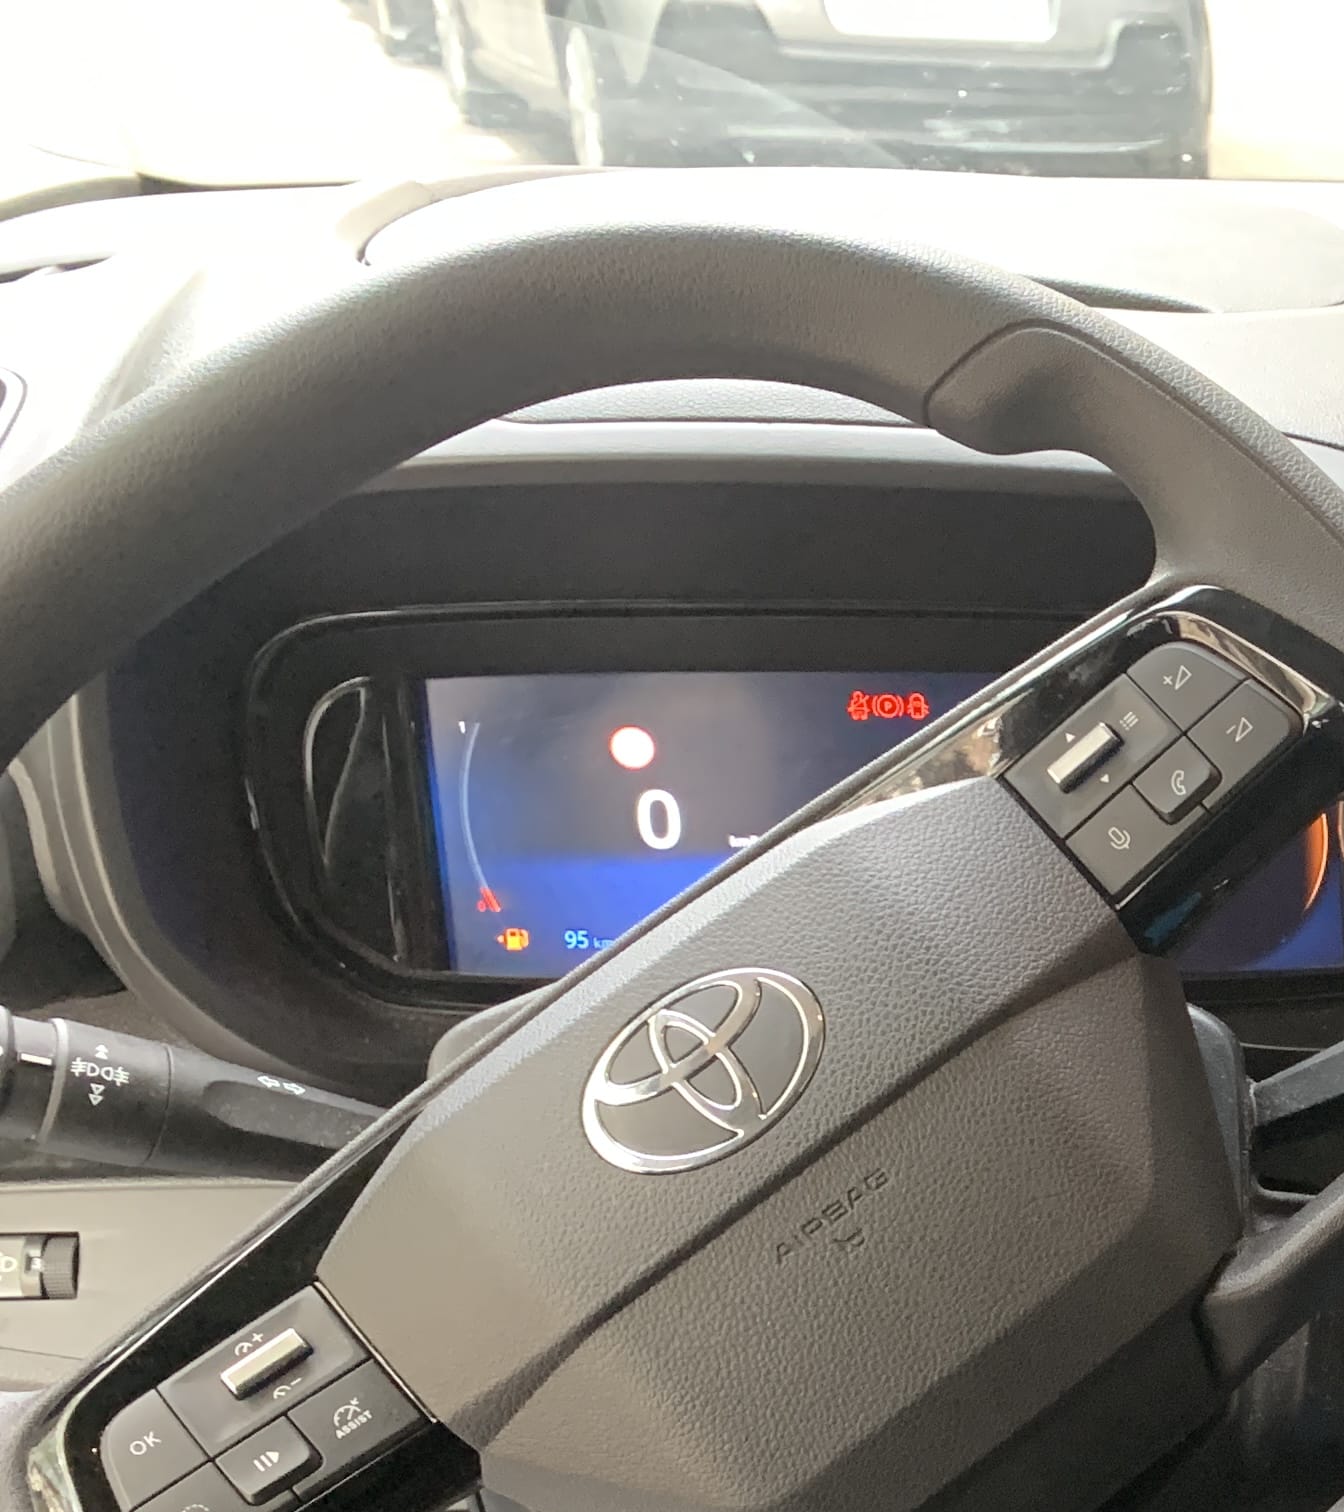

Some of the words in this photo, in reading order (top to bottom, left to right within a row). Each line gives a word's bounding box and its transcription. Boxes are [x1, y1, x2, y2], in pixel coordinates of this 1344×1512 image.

[637, 789, 681, 850] 0
[564, 930, 589, 949] 95
[335, 1410, 373, 1440] ASSIST
[129, 1431, 162, 1455] OK
